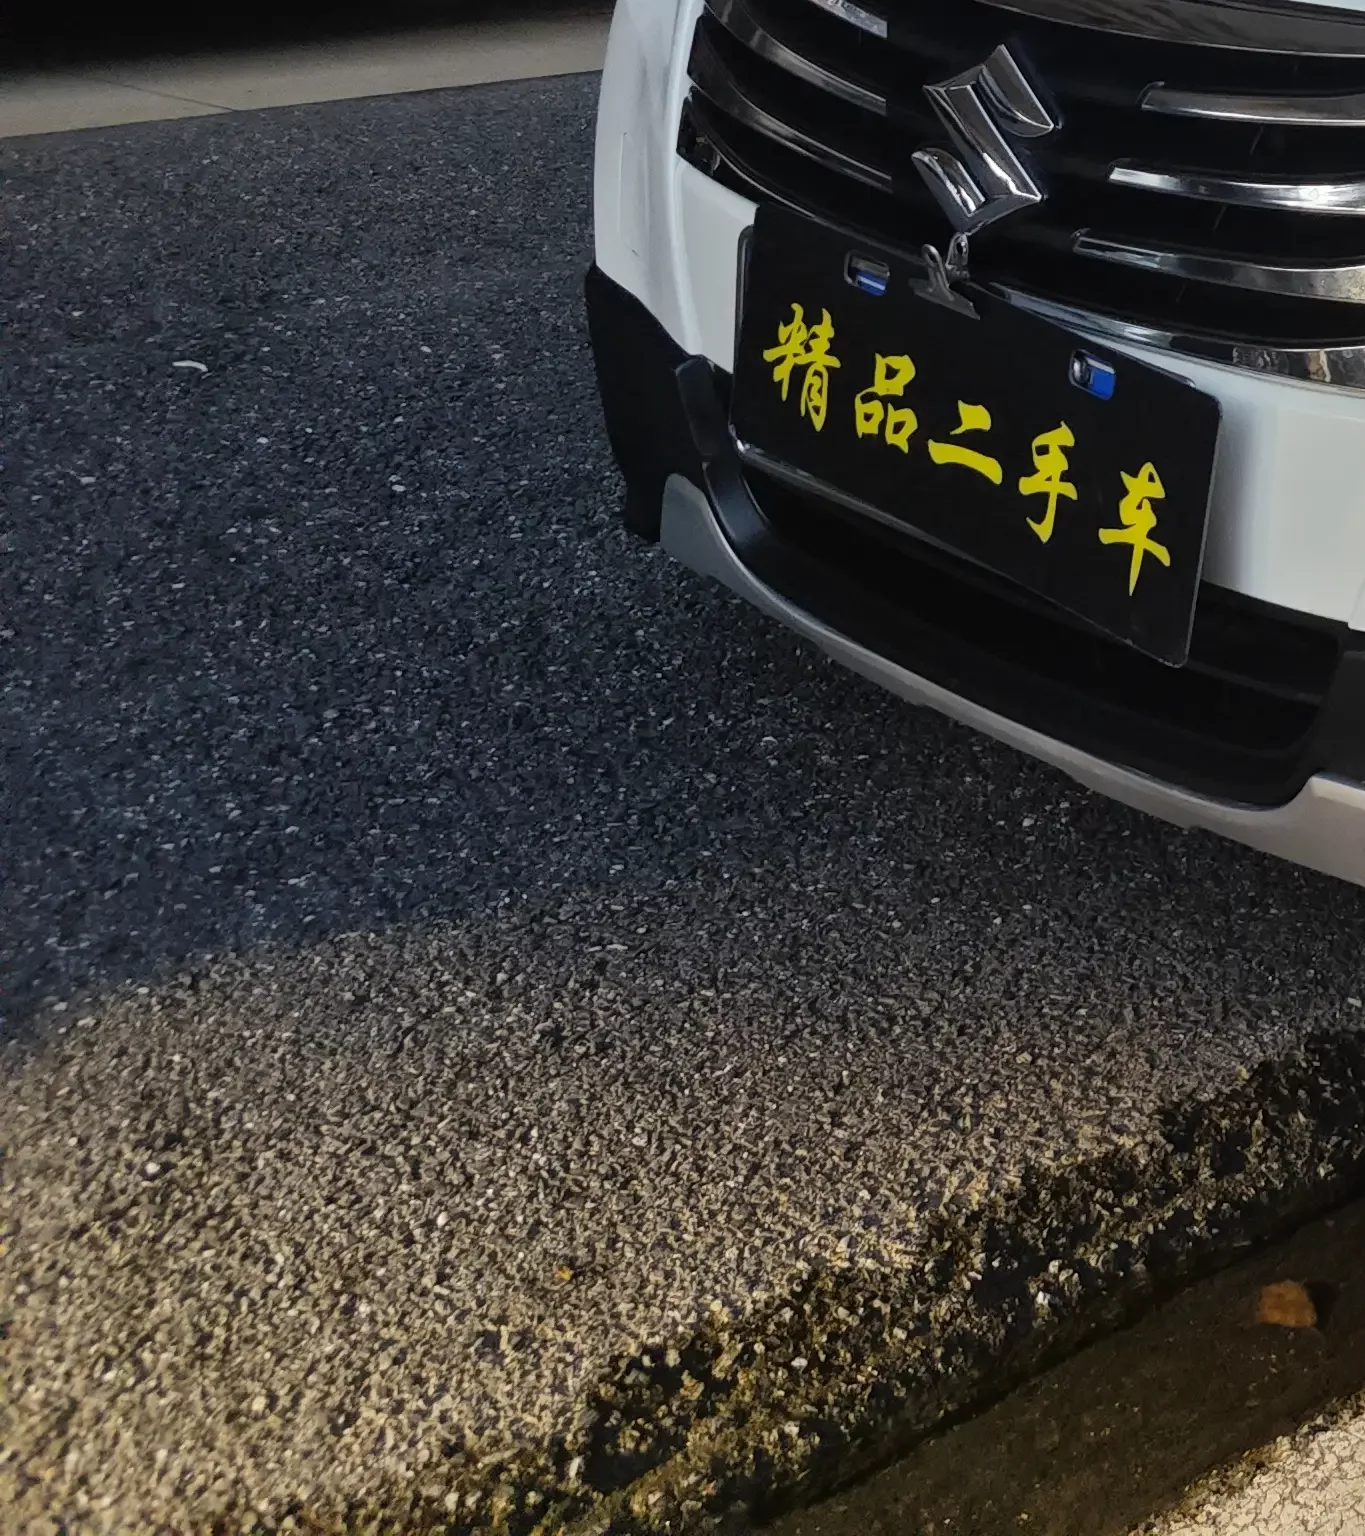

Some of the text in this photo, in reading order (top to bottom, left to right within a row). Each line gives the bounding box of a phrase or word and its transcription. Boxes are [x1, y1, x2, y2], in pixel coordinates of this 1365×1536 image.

[762, 302, 1171, 596] 精品二手车
